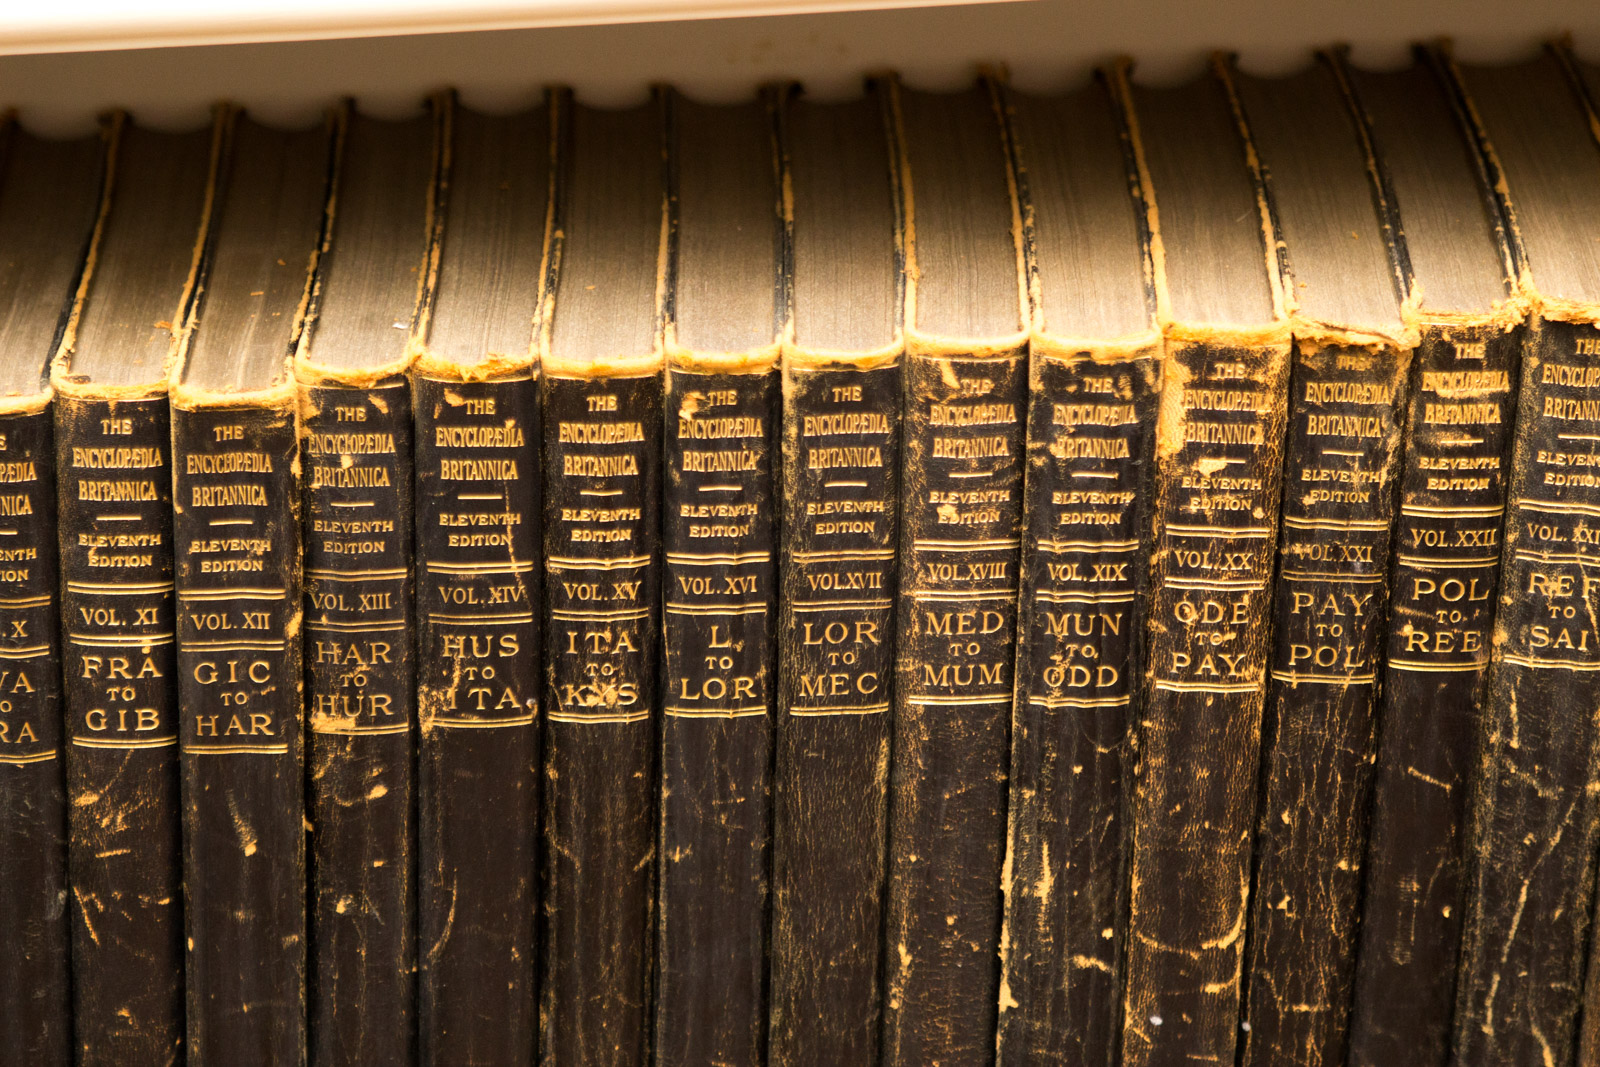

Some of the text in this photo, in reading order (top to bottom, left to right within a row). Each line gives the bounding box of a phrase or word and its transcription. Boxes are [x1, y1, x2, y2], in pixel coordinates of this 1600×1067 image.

[1455, 344, 1486, 359] THE
[1214, 364, 1245, 379] THE
[832, 386, 862, 402] THE
[961, 379, 993, 395] THE
[1084, 378, 1113, 393] THE
[465, 400, 495, 415] THE
[586, 396, 617, 411] THE
[707, 391, 737, 406] THE
[335, 407, 366, 422] THE
[1424, 403, 1501, 424] BRITANNICA
[101, 419, 132, 435] THE
[213, 426, 244, 441] THE
[559, 422, 645, 443] ENCYCLOPÆDIA
[678, 418, 763, 439] ENCYCLOPÆDIA
[803, 414, 890, 437] ENCYCLOPÆDIA
[1186, 423, 1264, 445] BRITANNICA
[1307, 415, 1381, 438] BRITANNICA
[435, 427, 525, 448] ENCYCLOPÆDIA
[933, 437, 1010, 459] BRITANNICA
[1055, 438, 1130, 459] BRITANNICA
[72, 448, 163, 468] ENCYCLOPÆDIA
[564, 455, 639, 476] BRITANNICA
[683, 451, 757, 472] BRITANNICA
[809, 447, 883, 469] BRITANNICA
[1419, 457, 1500, 470] ELEVENTH
[313, 467, 390, 488] BRITANNICA
[441, 460, 519, 481] BRITANNICA
[1301, 469, 1380, 483] ELEVENTH
[78, 481, 158, 501] BRITANNICA
[1182, 477, 1262, 490] ELEVENTH
[1427, 479, 1490, 490] EDITION
[192, 485, 268, 507] BRITANNICA
[929, 491, 1010, 504] ELEVENTH
[1052, 493, 1131, 505] ELEVENTH
[1191, 498, 1252, 511] EDITION
[1310, 490, 1370, 502] EDITION
[561, 508, 641, 522] ELEVENTH
[680, 504, 758, 518] ELEVENTH
[807, 502, 884, 516] ELEVENTH
[314, 520, 393, 533] ELEVENTH
[439, 513, 521, 526] ELEVENTH
[937, 512, 1000, 525] EDITION
[1061, 513, 1122, 525] EDITION
[571, 529, 632, 542] EDITION
[690, 526, 749, 538] EDITION
[816, 522, 875, 535] EDITION
[1527, 523, 1567, 542] VOL.
[78, 534, 161, 547] ELEVENTH
[190, 539, 271, 553] ELEVENTH
[449, 534, 511, 547] EDITION
[1411, 529, 1497, 547] VOL. XXII
[324, 542, 385, 554] EDITION
[1339, 547, 1373, 563] XXI
[88, 555, 152, 567] EDITION
[201, 561, 263, 573] EDITION
[1220, 554, 1254, 570] XX
[1047, 564, 1128, 582] VOL. XIX
[563, 581, 642, 601] VOL. XV
[678, 576, 757, 595] VOL. XVI
[1412, 578, 1490, 601] POL
[310, 593, 392, 611] VOL. XIII
[438, 586, 526, 604] VOL. XIV
[1174, 602, 1250, 625] ODE
[1292, 593, 1373, 617] PAY
[1549, 606, 1576, 618] TO
[80, 608, 159, 626] VOL. XI
[191, 612, 271, 630] VOL. XII
[925, 612, 1004, 636] MED
[1045, 613, 1123, 637] MUN
[1436, 610, 1461, 623] TO
[709, 626, 730, 649] L
[803, 622, 880, 645] LOR
[1195, 632, 1223, 646] TO
[1315, 624, 1343, 637] TO
[1530, 626, 1589, 650] SAI
[442, 635, 520, 658] HUS
[566, 631, 637, 655] ITA
[951, 643, 980, 656] TO
[1405, 631, 1482, 653] REE
[316, 641, 392, 665] HAR
[828, 652, 855, 666] TO
[1288, 645, 1365, 667] POL
[81, 657, 163, 679] FRA
[194, 661, 270, 684] GIC
[586, 663, 613, 677] TO
[705, 657, 733, 670] TO
[1169, 654, 1247, 676] PAY
[340, 674, 367, 687] TO
[465, 667, 495, 680] TO
[924, 664, 1003, 687] MUM
[1043, 666, 1118, 688] ODD
[106, 687, 136, 701] TO
[680, 678, 757, 700] LOR
[799, 673, 878, 697] MEC
[220, 692, 248, 706] TO
[449, 687, 520, 710] ITA
[564, 683, 638, 707] KYS
[317, 694, 394, 717] HUR
[85, 709, 160, 731] GIB
[196, 714, 274, 736] HAR
